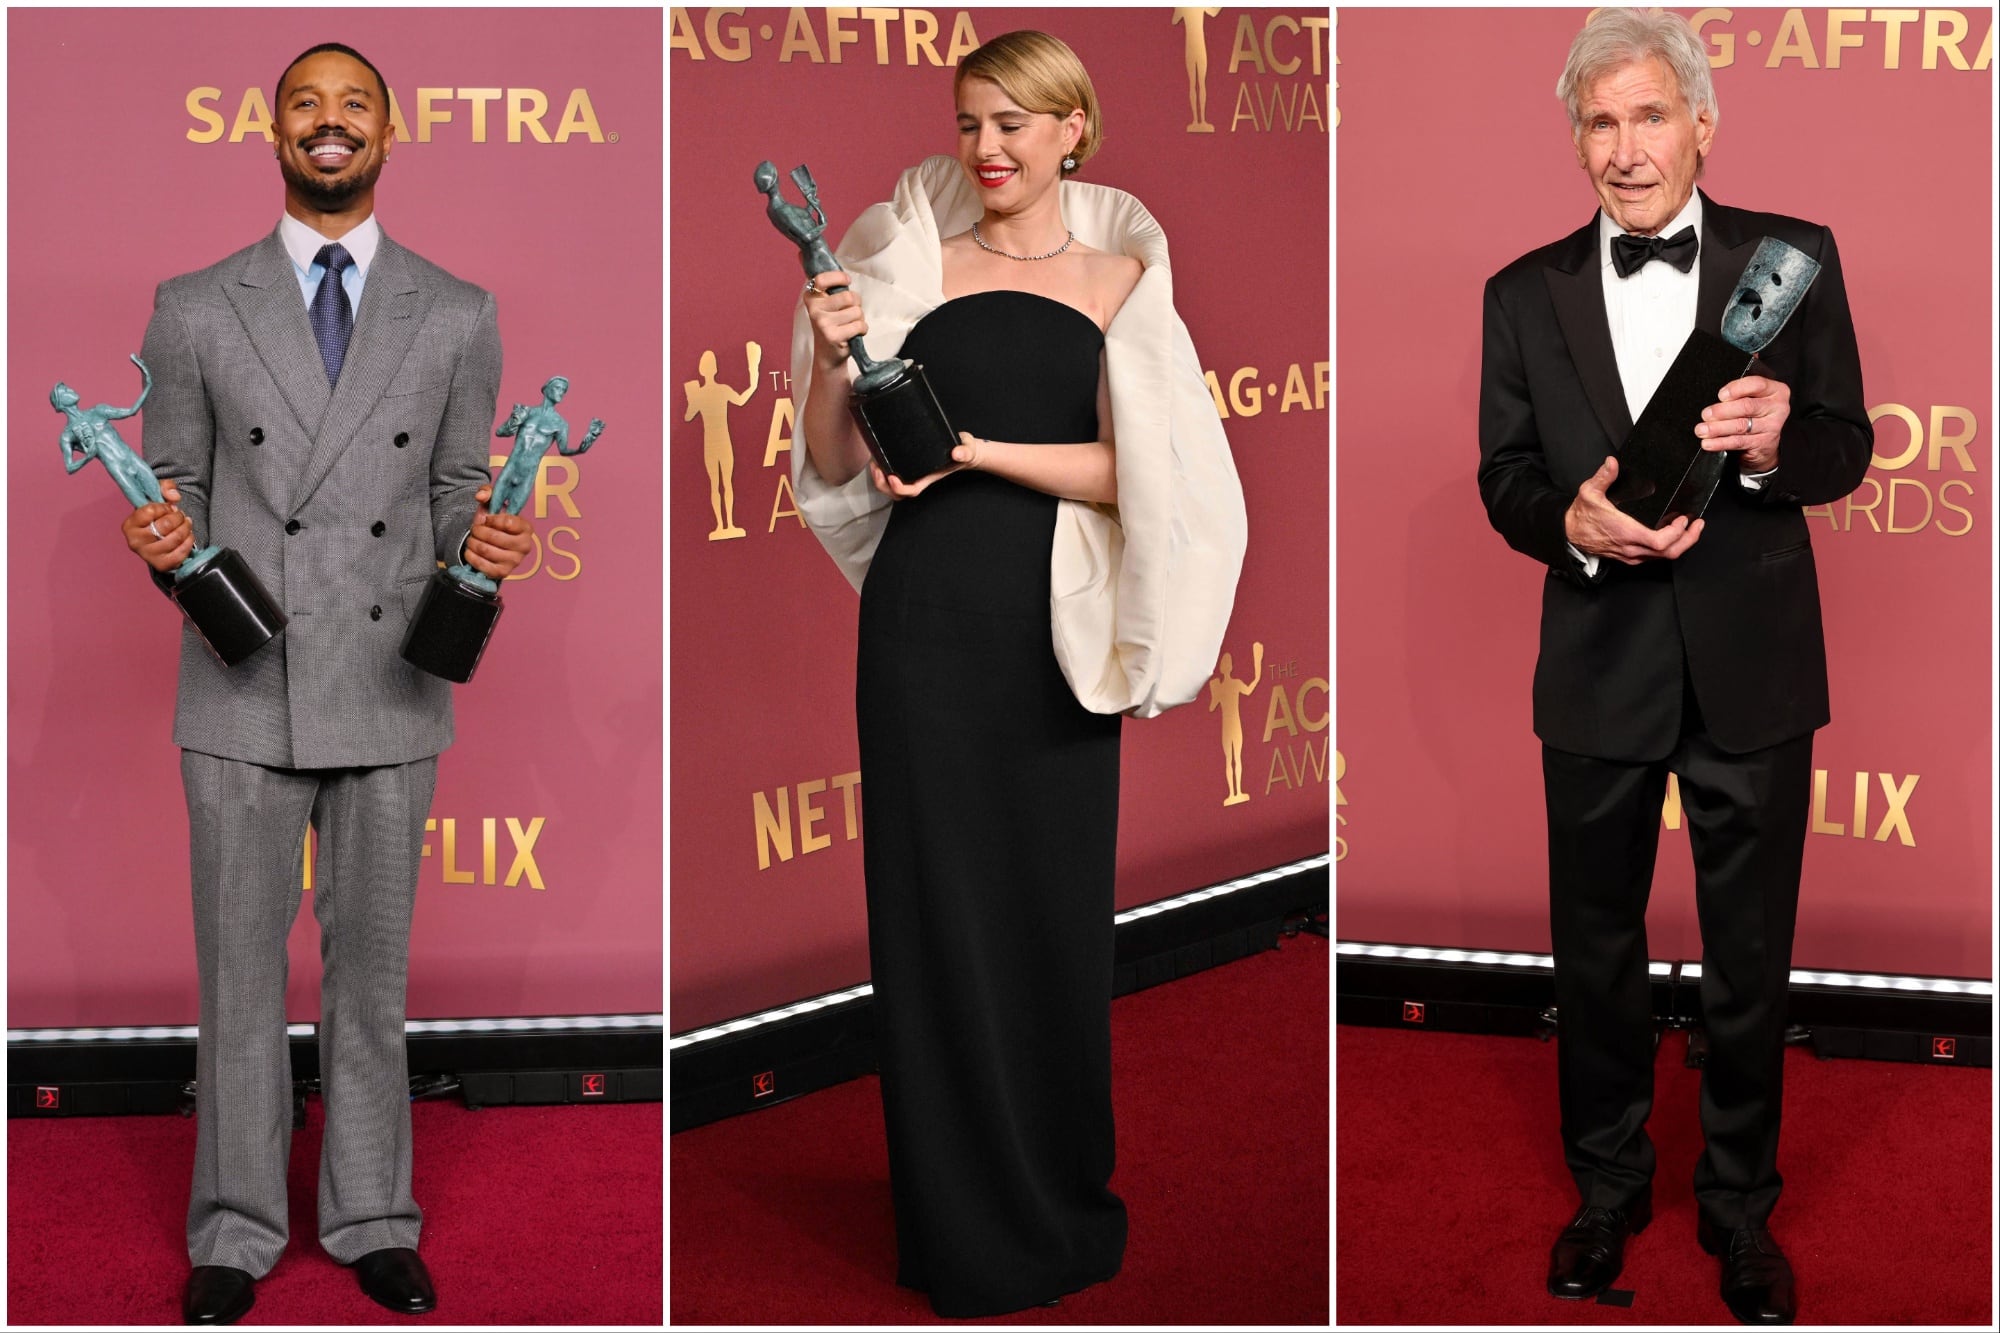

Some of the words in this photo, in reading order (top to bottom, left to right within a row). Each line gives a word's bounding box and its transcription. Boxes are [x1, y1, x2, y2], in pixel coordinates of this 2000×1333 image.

[1228, 14, 1329, 75] ACT
[1691, 8, 1992, 70] G·AFTR
[1231, 82, 1329, 132] AWA
[769, 370, 792, 391] TH
[1269, 661, 1297, 680] THE
